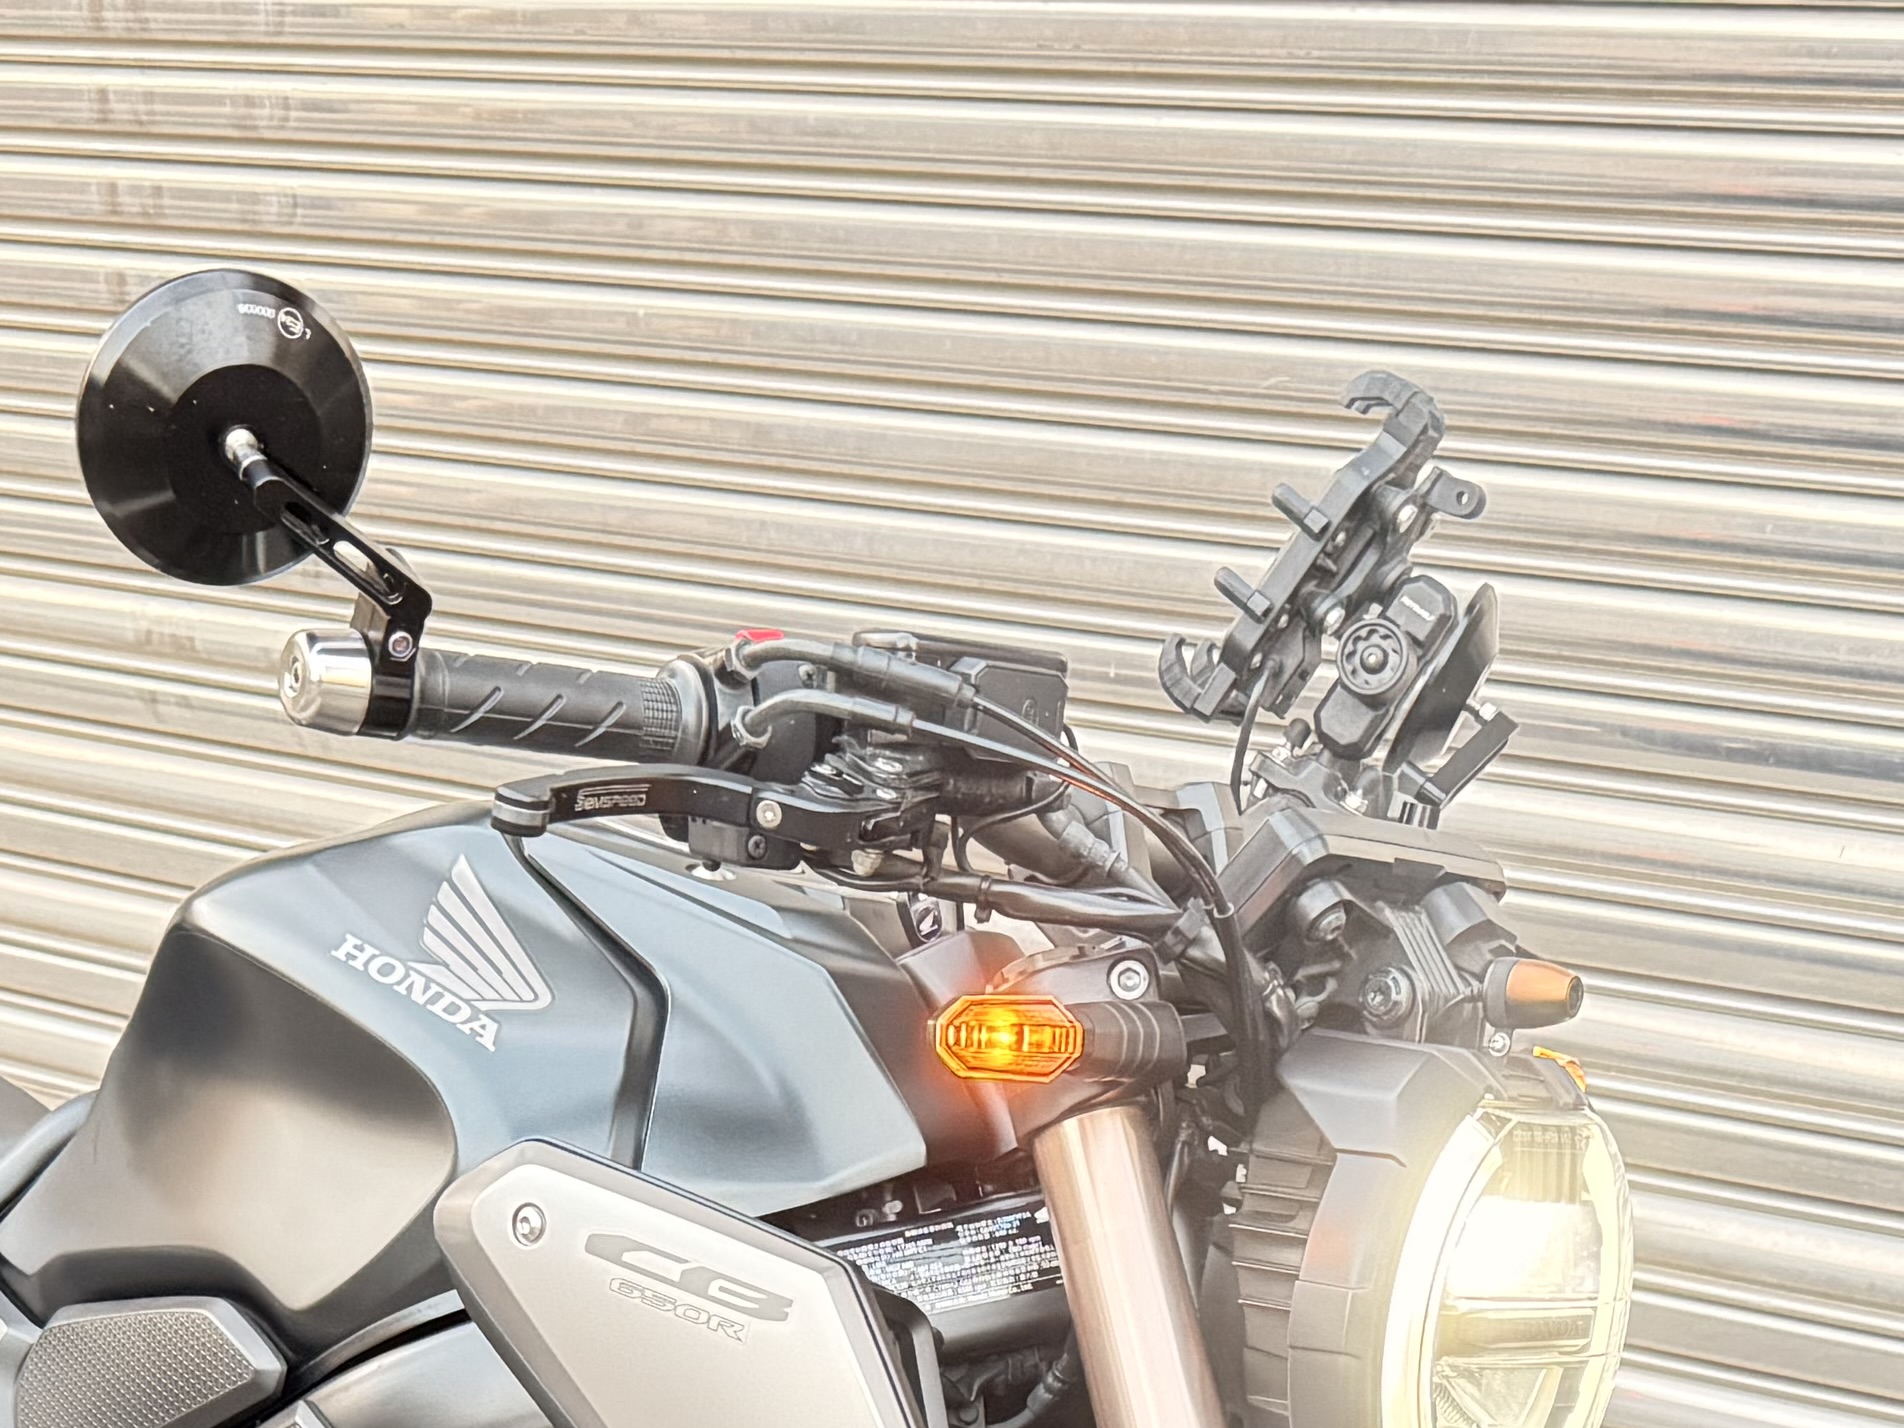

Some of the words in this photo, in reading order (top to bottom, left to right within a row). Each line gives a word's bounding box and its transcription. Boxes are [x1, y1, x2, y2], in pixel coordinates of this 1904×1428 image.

[330, 932, 500, 1053] HONDA
[584, 1232, 794, 1322] CB
[608, 1277, 746, 1343] 650R
